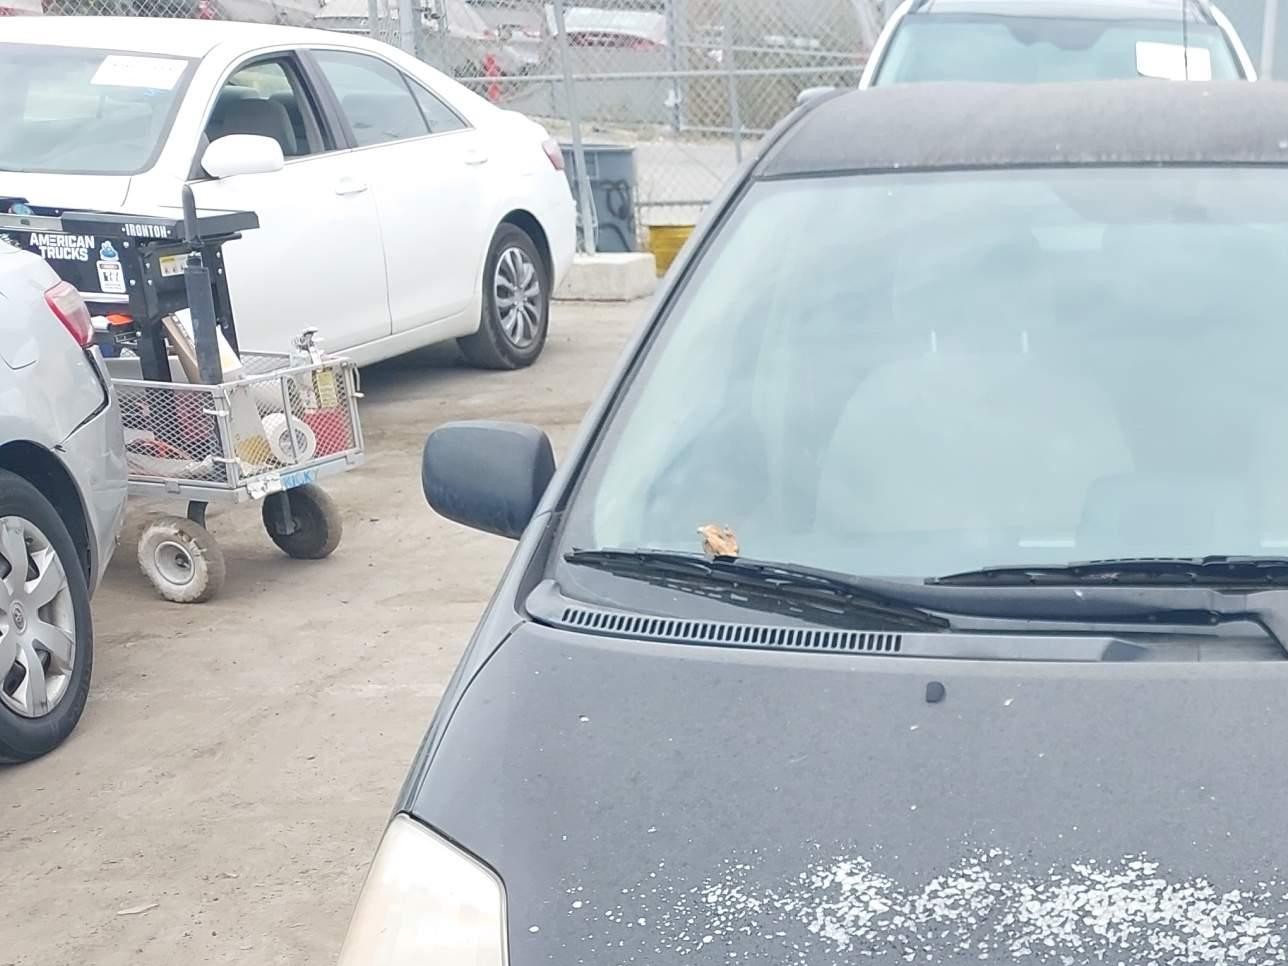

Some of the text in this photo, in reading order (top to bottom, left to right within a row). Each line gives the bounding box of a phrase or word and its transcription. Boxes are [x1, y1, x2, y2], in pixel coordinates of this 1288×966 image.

[125, 223, 167, 238] IRONTON
[30, 233, 95, 249] AMERICAN
[38, 246, 89, 262] TRUCKS
